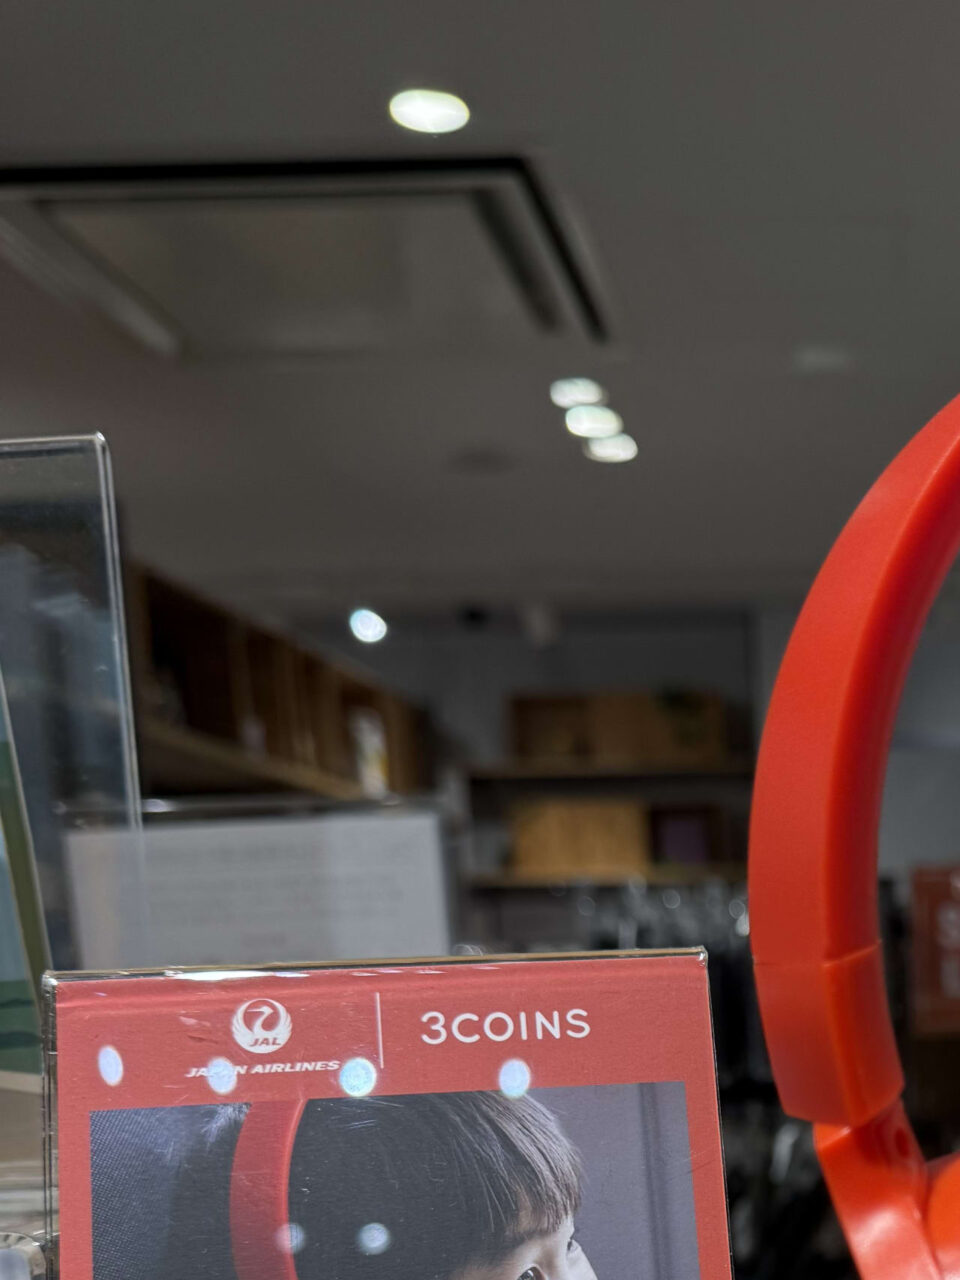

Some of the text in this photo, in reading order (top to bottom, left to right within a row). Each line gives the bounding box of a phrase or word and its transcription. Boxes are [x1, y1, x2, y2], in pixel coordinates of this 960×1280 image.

[420, 1008, 591, 1045] 3COINS
[248, 1036, 283, 1048] JAL
[184, 1060, 341, 1078] JAN AIRLINES
